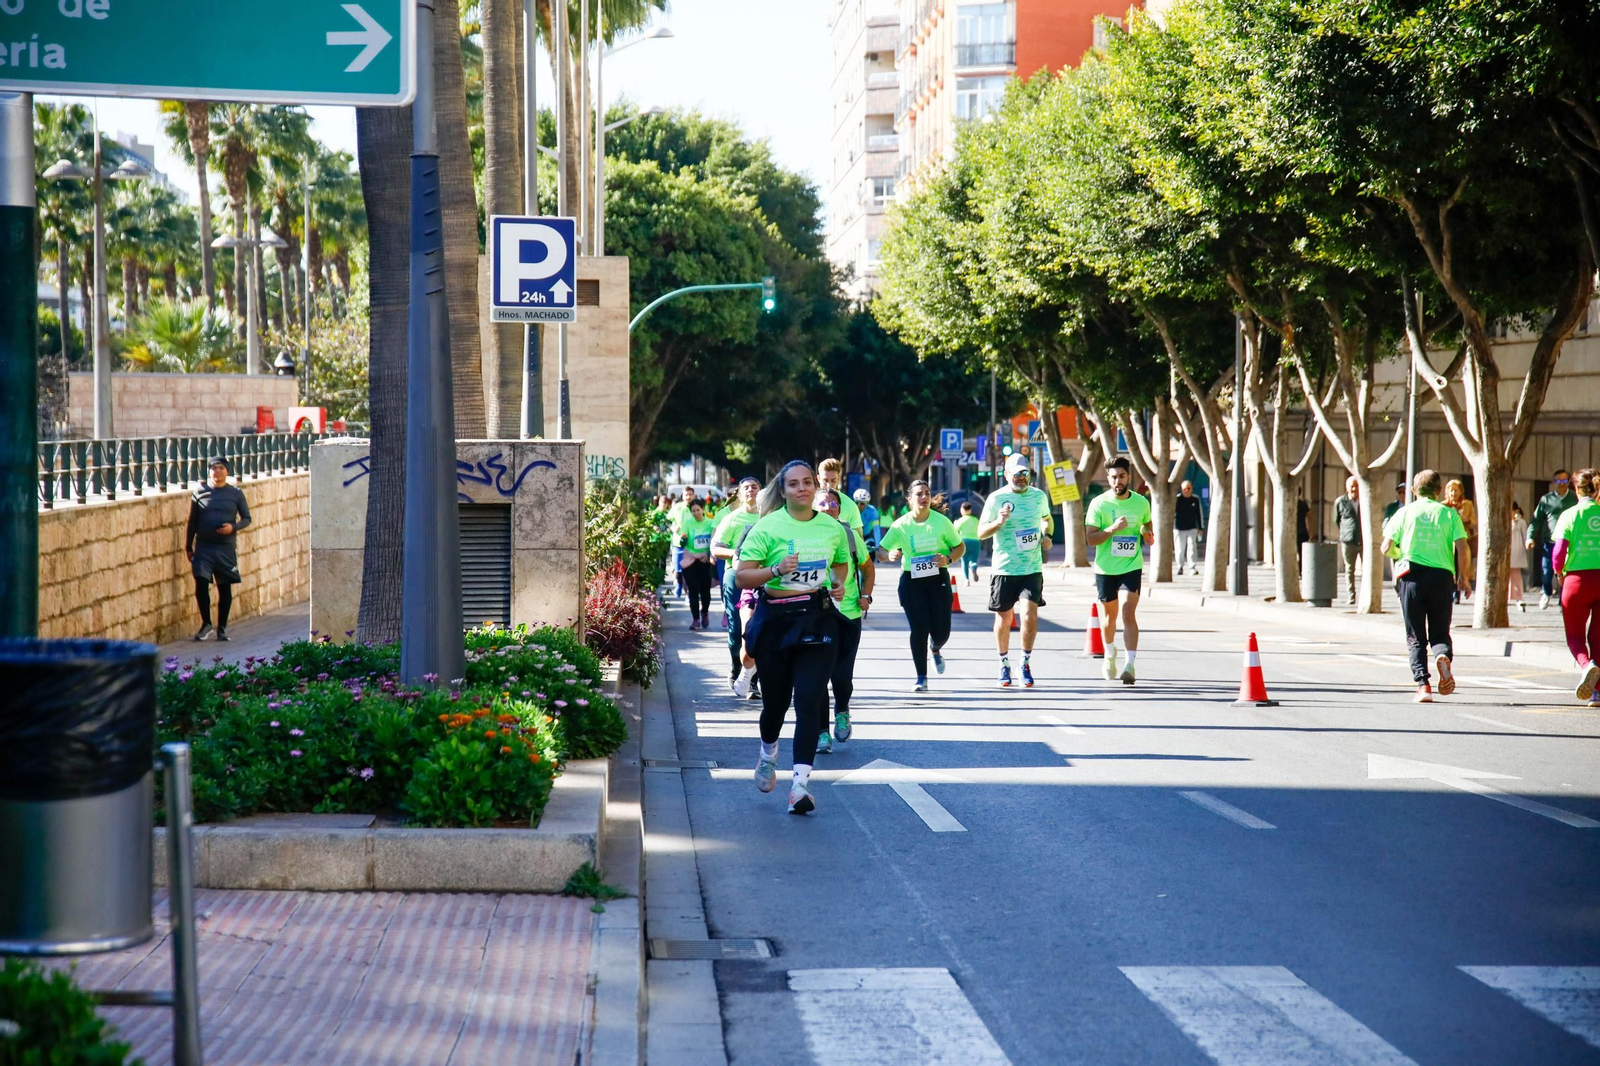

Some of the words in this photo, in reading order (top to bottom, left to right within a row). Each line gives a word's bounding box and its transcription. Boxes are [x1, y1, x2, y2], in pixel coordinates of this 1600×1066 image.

[0, 0, 24, 15] o
[500, 223, 567, 302] P
[521, 291, 546, 303] 24h
[498, 311, 522, 319] Hnos.
[524, 311, 570, 320] MACHADO
[946, 433, 957, 448] P
[1022, 534, 1038, 543] 584
[1117, 542, 1135, 550] 302
[915, 561, 934, 571] 583
[790, 570, 818, 583] 214
